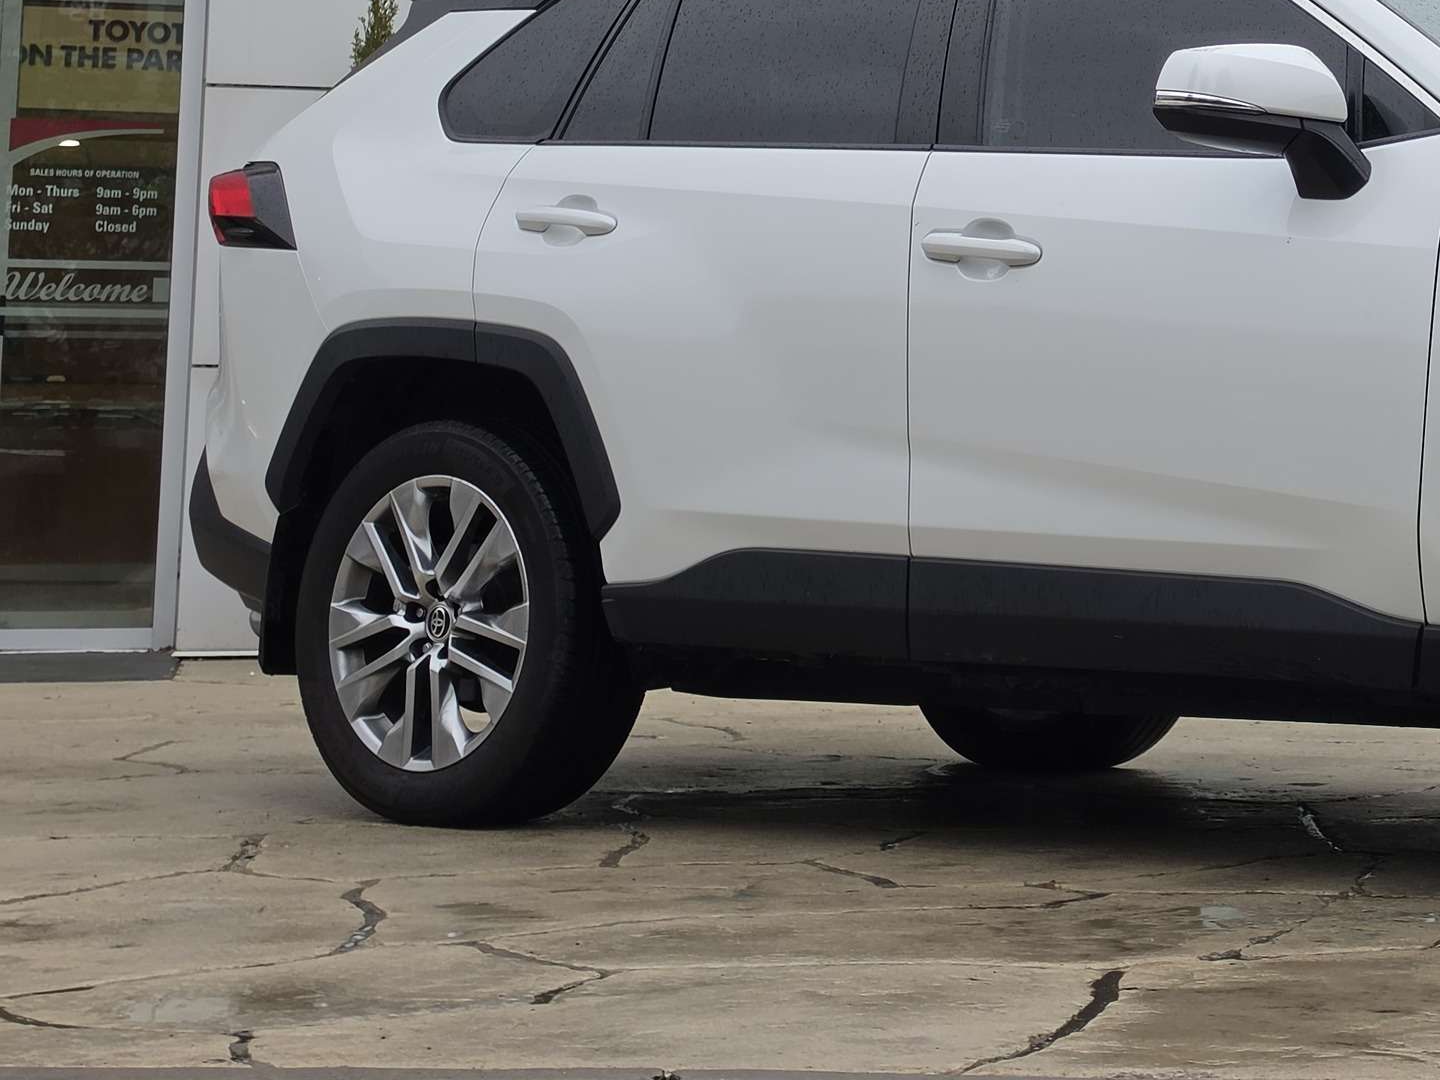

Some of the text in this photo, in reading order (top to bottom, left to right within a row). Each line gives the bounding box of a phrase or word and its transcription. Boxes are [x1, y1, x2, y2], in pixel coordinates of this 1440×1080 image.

[88, 19, 183, 45] TOYOT
[60, 45, 117, 69] THE
[126, 47, 182, 72] PAR
[29, 167, 140, 179] SALES HOURS OF OPERATION
[7, 184, 34, 197] Mon
[45, 184, 80, 198] Thurs
[96, 186, 122, 199] 9am
[132, 186, 158, 202] 9pm
[32, 201, 53, 214] Sat
[95, 203, 121, 216] 9am
[131, 204, 157, 219] 6pm
[95, 220, 137, 233] Closed
[6, 271, 148, 303] Welcome
